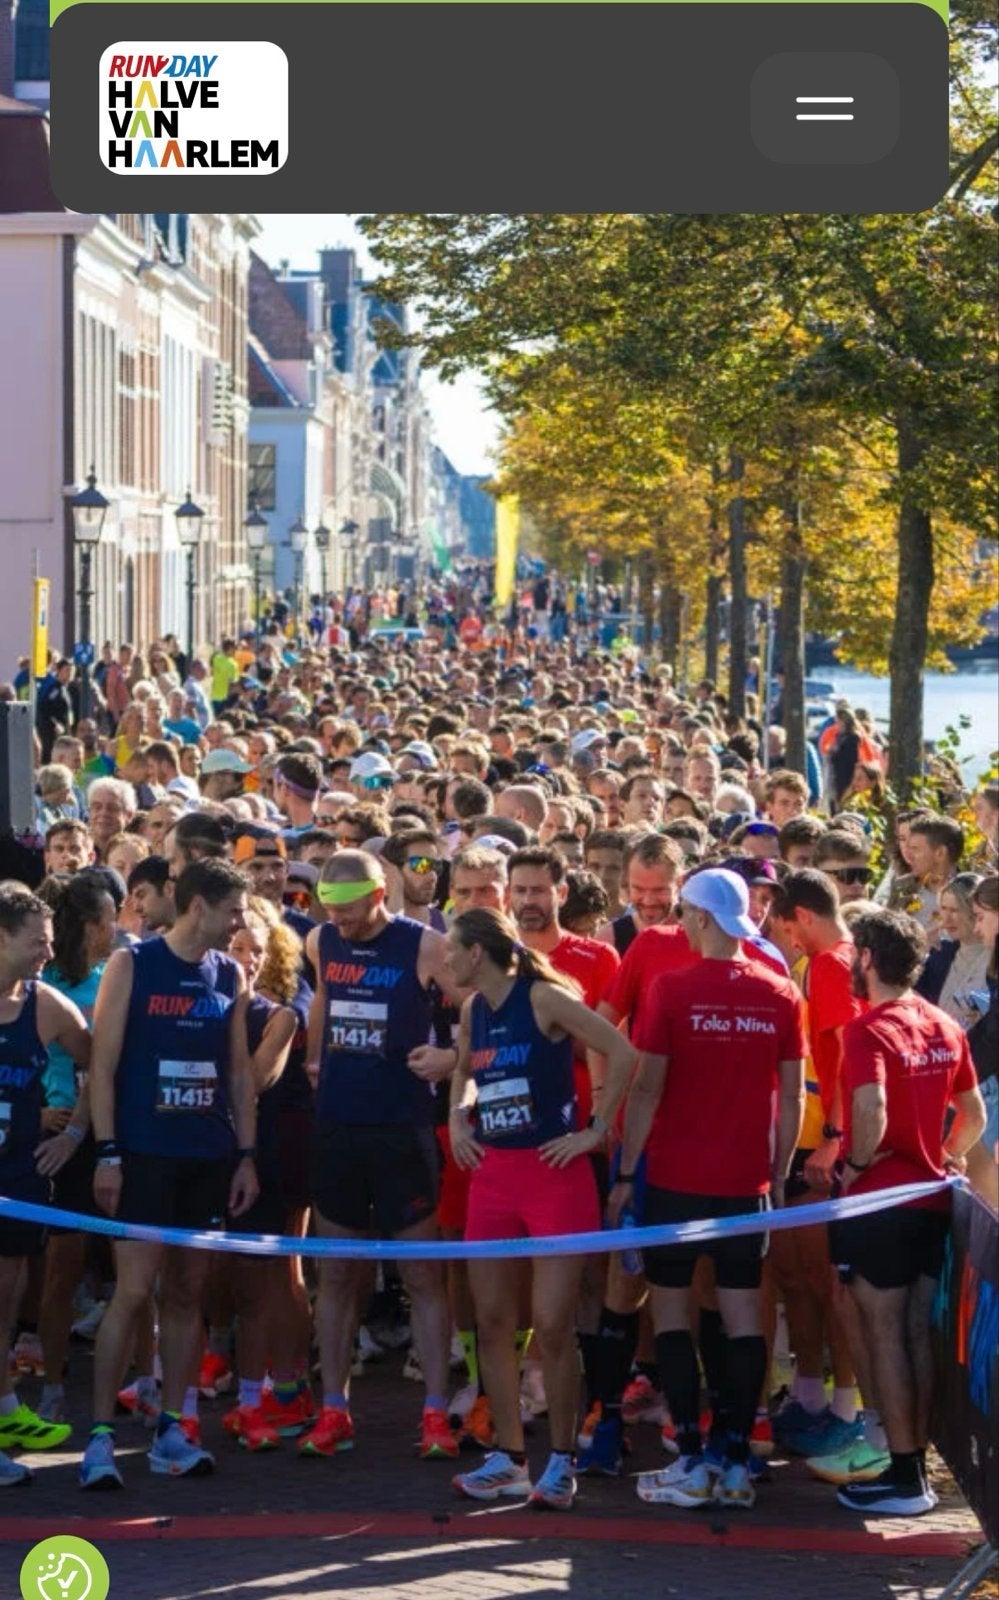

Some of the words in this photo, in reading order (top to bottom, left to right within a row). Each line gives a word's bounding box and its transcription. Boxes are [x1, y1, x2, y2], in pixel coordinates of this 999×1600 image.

[690, 1014, 731, 1031] Toko
[735, 1016, 776, 1034] Nina
[331, 1025, 382, 1047] 11414
[162, 1087, 214, 1106] 11413
[480, 1104, 532, 1131] 11421
